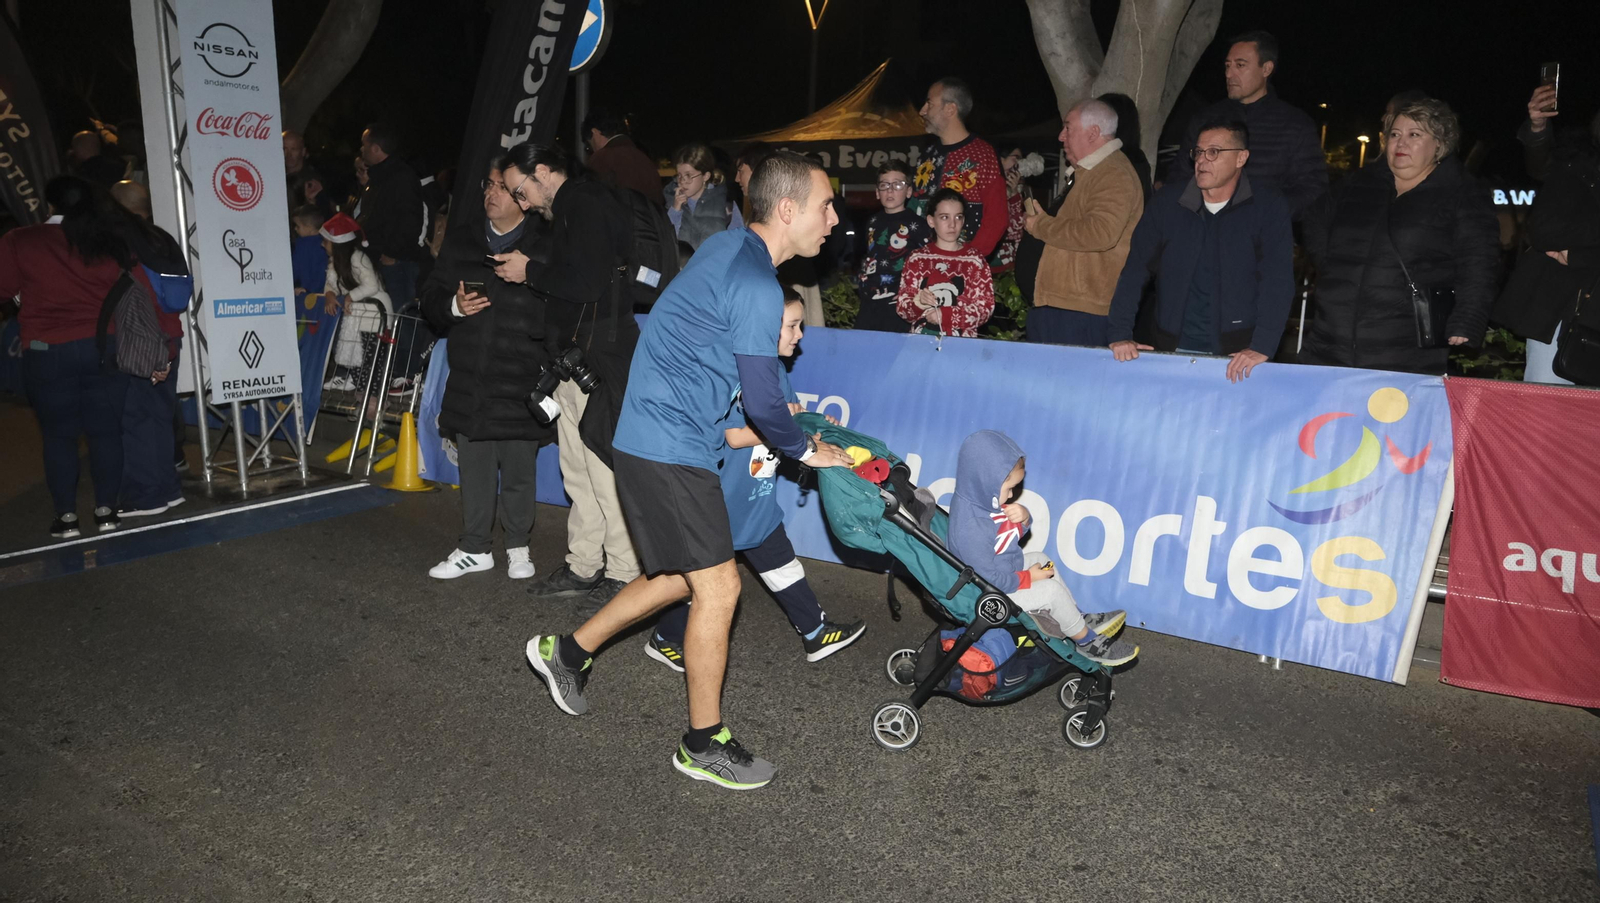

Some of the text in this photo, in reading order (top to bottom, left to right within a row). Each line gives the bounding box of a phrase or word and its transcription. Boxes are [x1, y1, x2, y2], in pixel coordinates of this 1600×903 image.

[194, 41, 259, 60] NISSAN
[204, 79, 260, 92] andalmotor.es
[217, 301, 264, 316] Almericar
[222, 375, 286, 390] RENAULT
[224, 386, 286, 400] SYRSA AUTOMOCION
